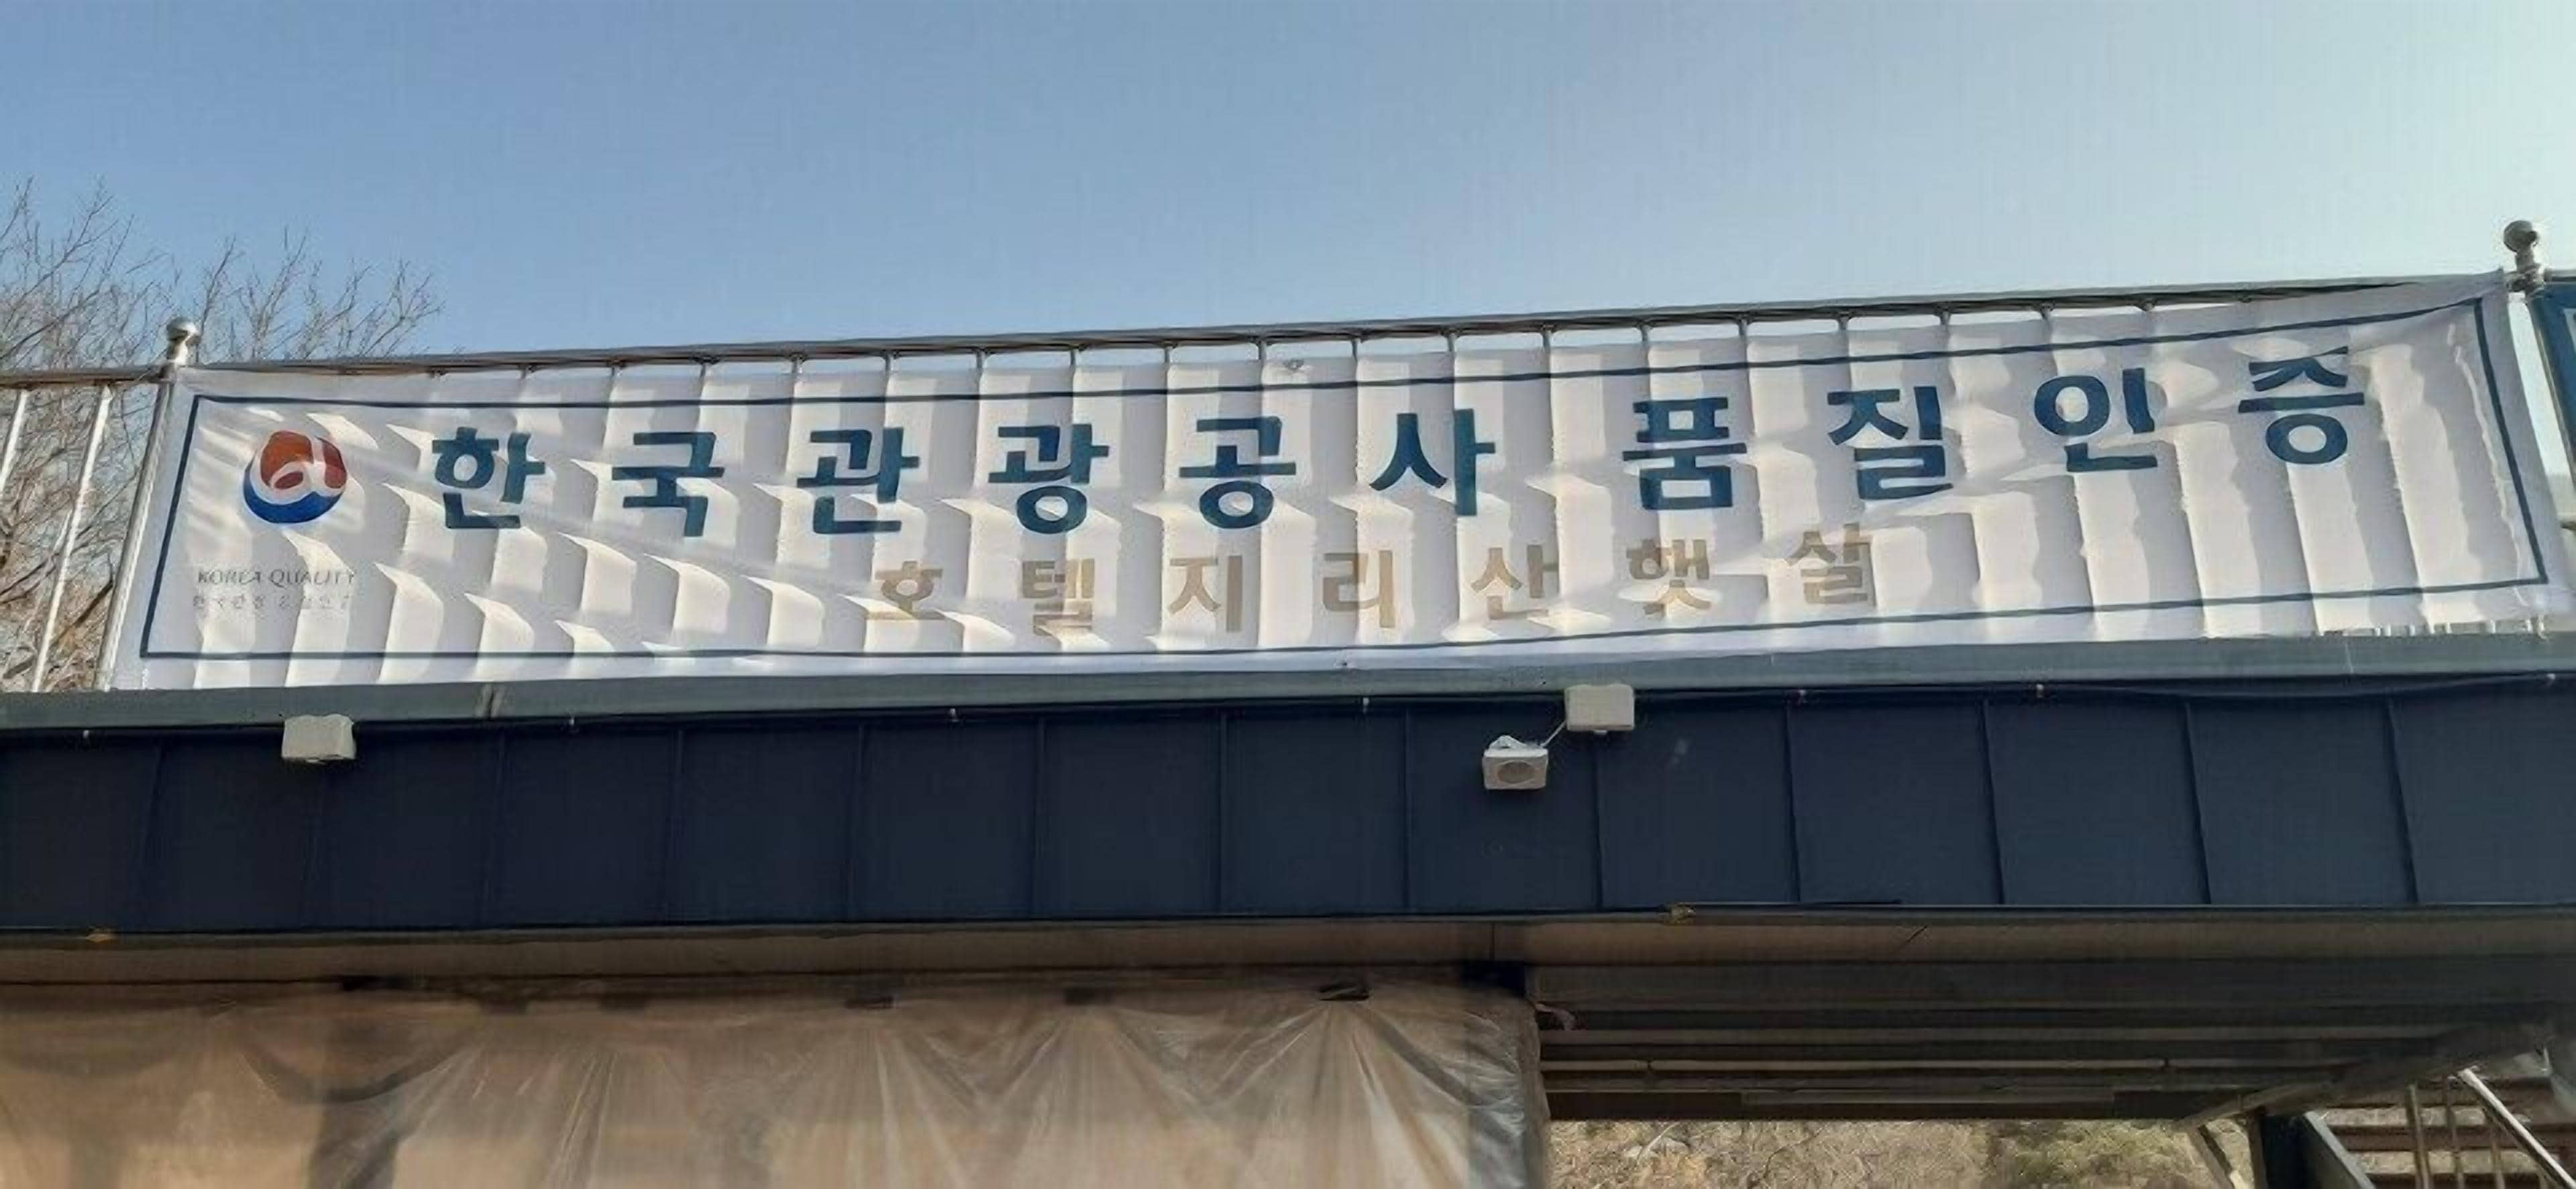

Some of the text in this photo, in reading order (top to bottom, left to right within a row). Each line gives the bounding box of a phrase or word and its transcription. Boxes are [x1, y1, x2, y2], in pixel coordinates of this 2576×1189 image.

[431, 346, 2365, 537] 한국관광공사 품질인증
[197, 569, 356, 588] KOREA QUALITY
